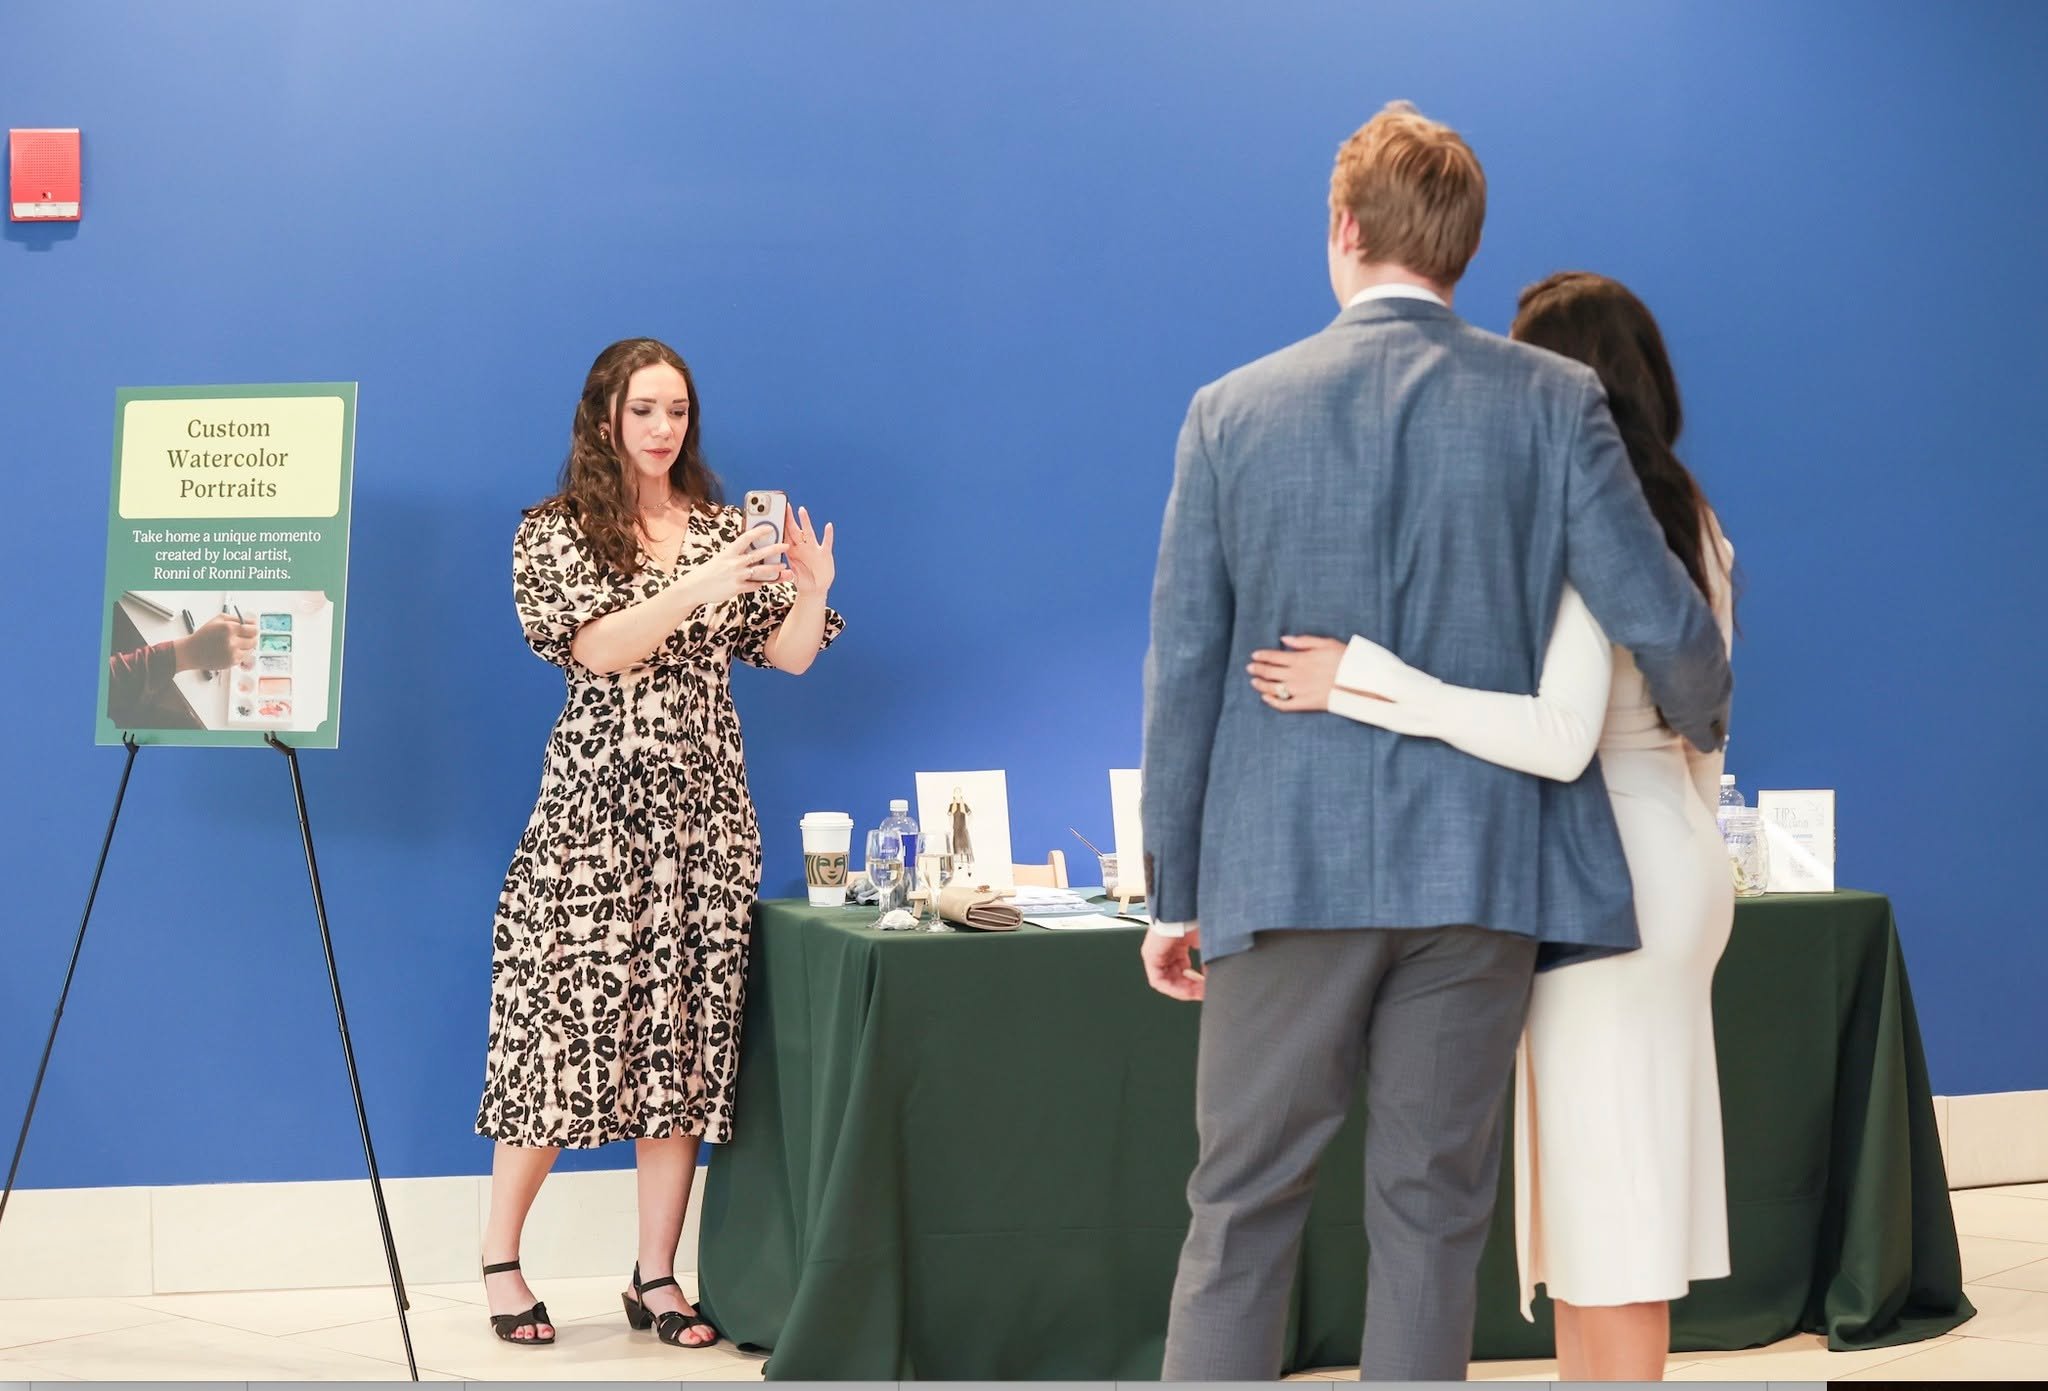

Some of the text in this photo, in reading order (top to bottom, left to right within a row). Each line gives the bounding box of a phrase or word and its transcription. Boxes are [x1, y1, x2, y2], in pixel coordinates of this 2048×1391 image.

[187, 419, 270, 438] Custom
[167, 448, 289, 468] Watercolor
[180, 478, 277, 498] Portraits
[133, 529, 321, 545] Take home a unique momento
[155, 548, 291, 563] created by local artist,
[154, 566, 291, 579] Ronni of Ronni Paints.
[1774, 807, 1797, 820] TIPS
